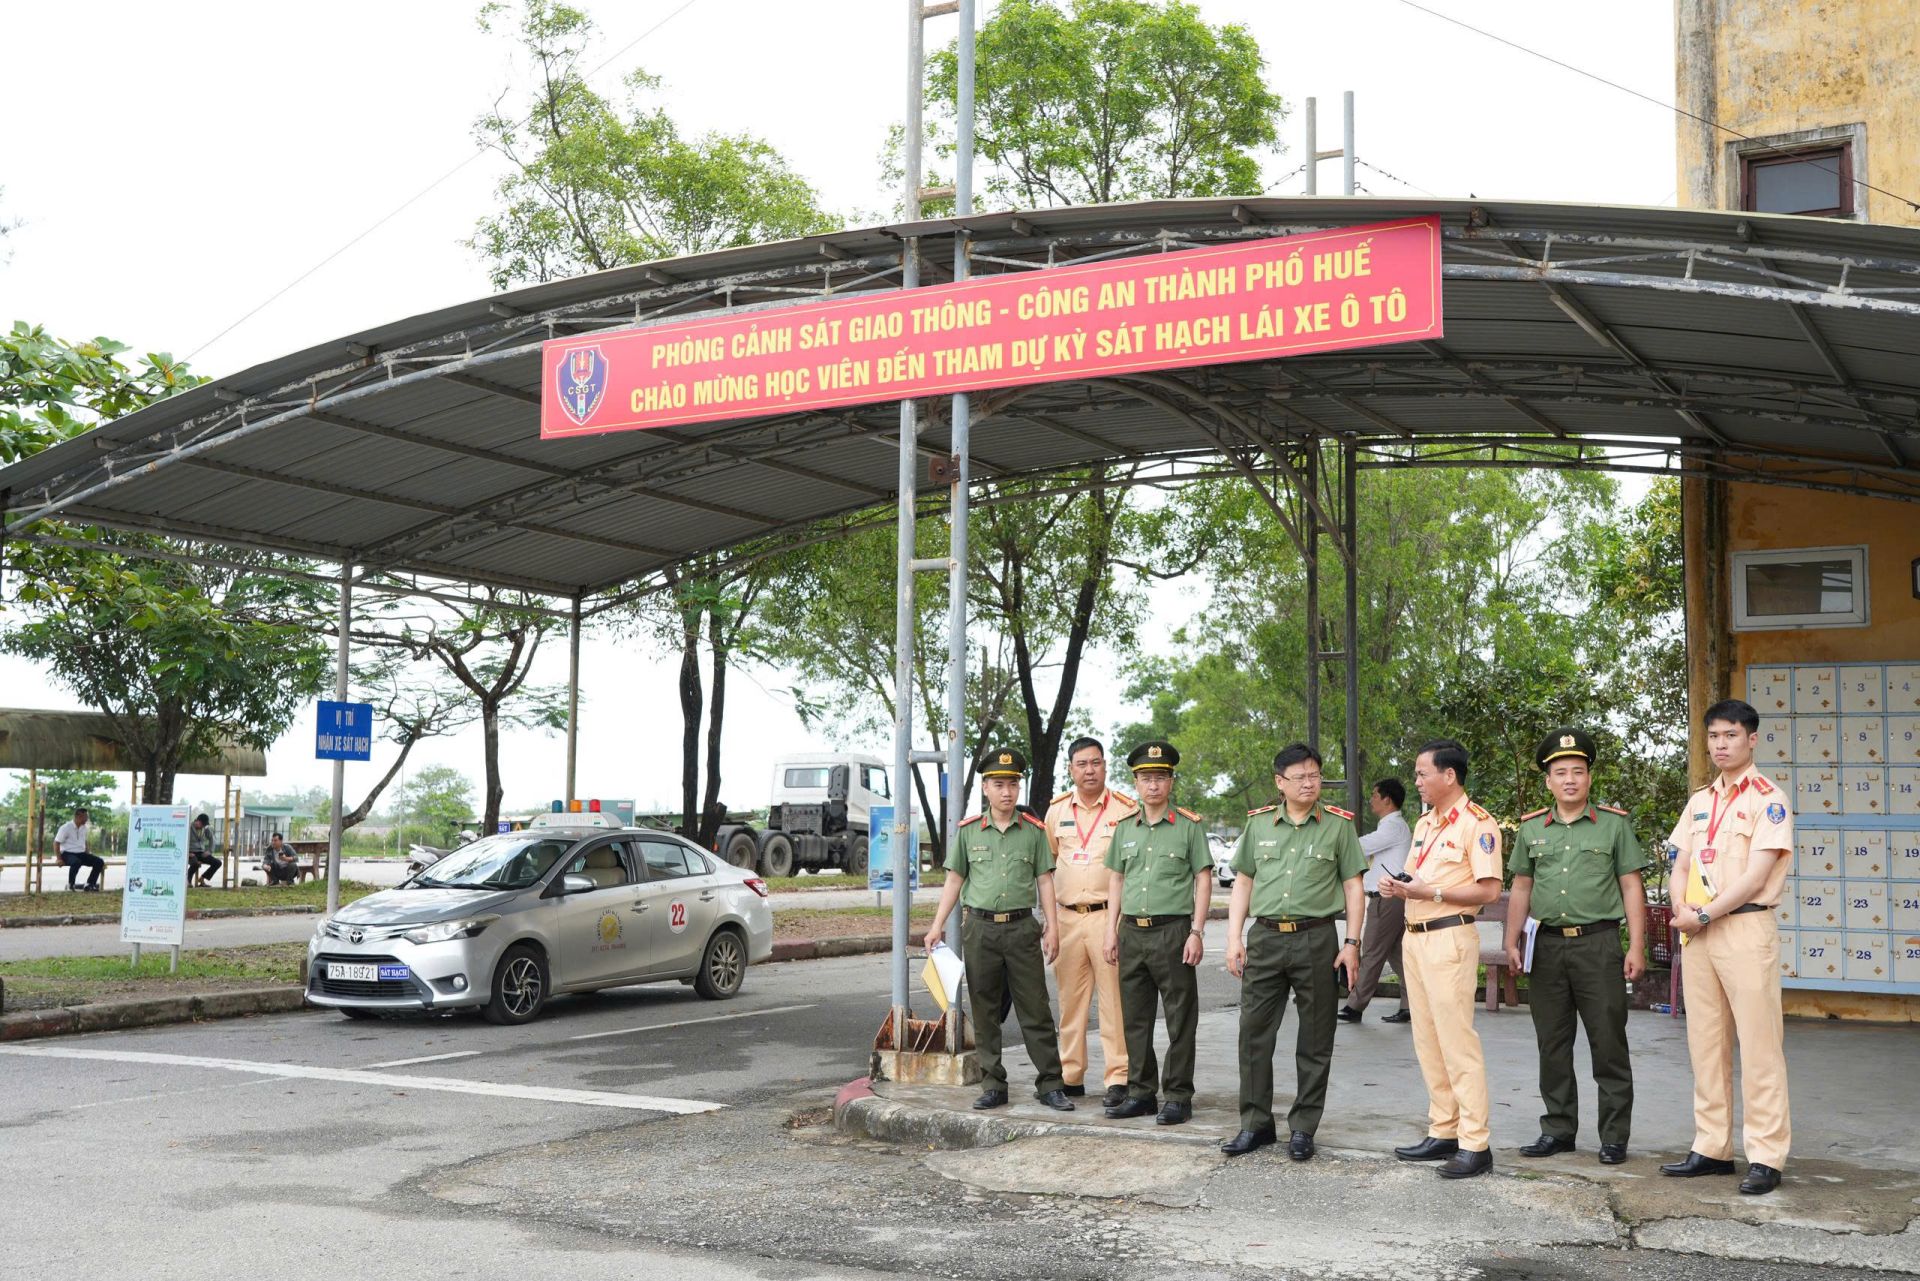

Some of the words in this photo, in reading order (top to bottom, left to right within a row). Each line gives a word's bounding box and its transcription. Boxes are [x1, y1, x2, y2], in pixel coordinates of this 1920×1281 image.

[652, 335, 725, 369] PHÒNG
[731, 324, 792, 358] CẢNH
[799, 317, 842, 350] SÁT
[849, 312, 903, 343] GIAO
[911, 299, 992, 334] THÔNG
[1018, 286, 1089, 320] CÔNG
[1098, 280, 1136, 310] AN
[1144, 267, 1236, 304] THÀNH
[1246, 247, 1304, 291] PHỐ
[1314, 238, 1373, 282] HUẾ
[630, 381, 687, 413] CHÀO
[693, 373, 759, 406] MỪNG
[766, 368, 810, 400] HỌC
[817, 357, 870, 391] VIÊN
[877, 346, 925, 384] ĐẾN
[933, 343, 1003, 376] THAM
[1011, 335, 1049, 371] DỰ
[1054, 328, 1087, 362] KỲ
[1096, 322, 1147, 357] SÁT
[1156, 315, 1231, 354] HẠCH
[1240, 304, 1284, 341] LÁI
[1294, 303, 1331, 334] XE
[1341, 293, 1360, 328] Ô
[1370, 287, 1407, 324] TÔ
[568, 383, 596, 395] CSGT
[1765, 686, 1771, 695] 1
[1812, 686, 1820, 695] 2
[1857, 683, 1865, 692] 3
[1902, 682, 1911, 691] 4
[1766, 733, 1774, 742] 6
[1810, 734, 1818, 743] 7
[1859, 732, 1867, 741] 8
[1904, 731, 1912, 741] 9
[334, 735, 342, 751] XE
[342, 733, 354, 752] SÁT
[1807, 783, 1821, 793] 12
[1856, 782, 1870, 791] 13
[1899, 784, 1912, 793] 14
[134, 817, 142, 833] 4
[1811, 847, 1825, 856] 17
[1854, 847, 1868, 856] 18
[1905, 848, 1919, 858] 19
[1807, 897, 1822, 906] 22
[1854, 899, 1869, 908] 23
[1903, 899, 1919, 909] 24
[671, 903, 685, 926] 22
[1809, 948, 1825, 957] 27
[1856, 950, 1872, 960] 28
[1906, 949, 1920, 959] 29
[380, 967, 391, 977] SÁT
